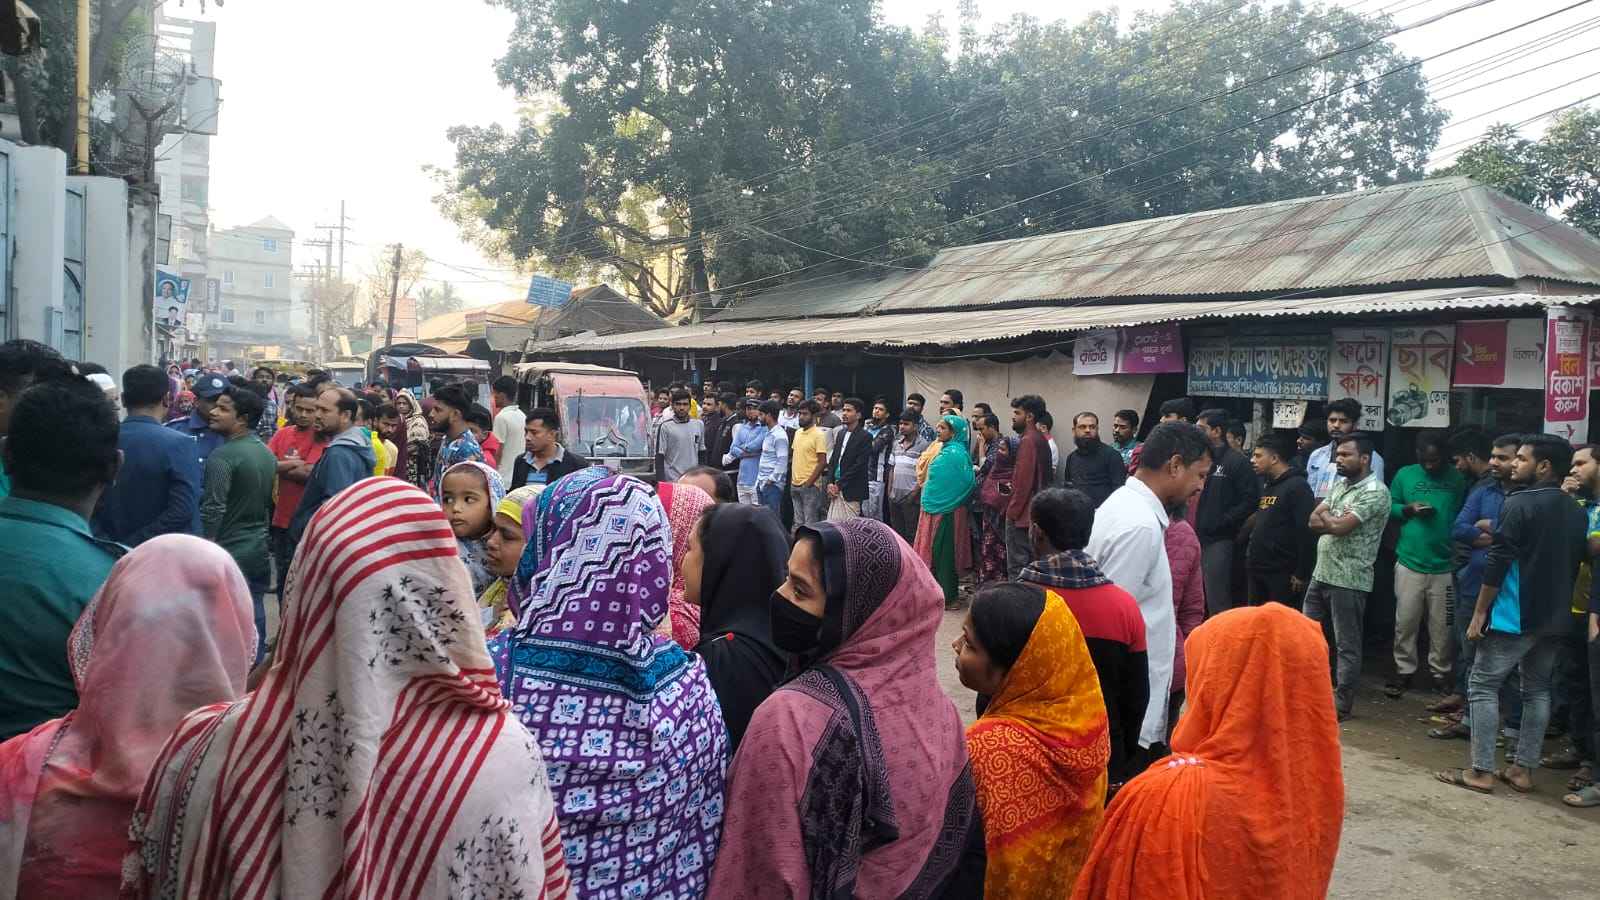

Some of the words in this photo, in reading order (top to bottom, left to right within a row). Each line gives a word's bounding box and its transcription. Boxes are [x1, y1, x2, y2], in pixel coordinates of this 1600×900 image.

[1393, 329, 1452, 383] ছবি
[1559, 352, 1580, 376] বিল
[1551, 371, 1585, 394] বিকাশ
[1554, 396, 1580, 414] করুন
